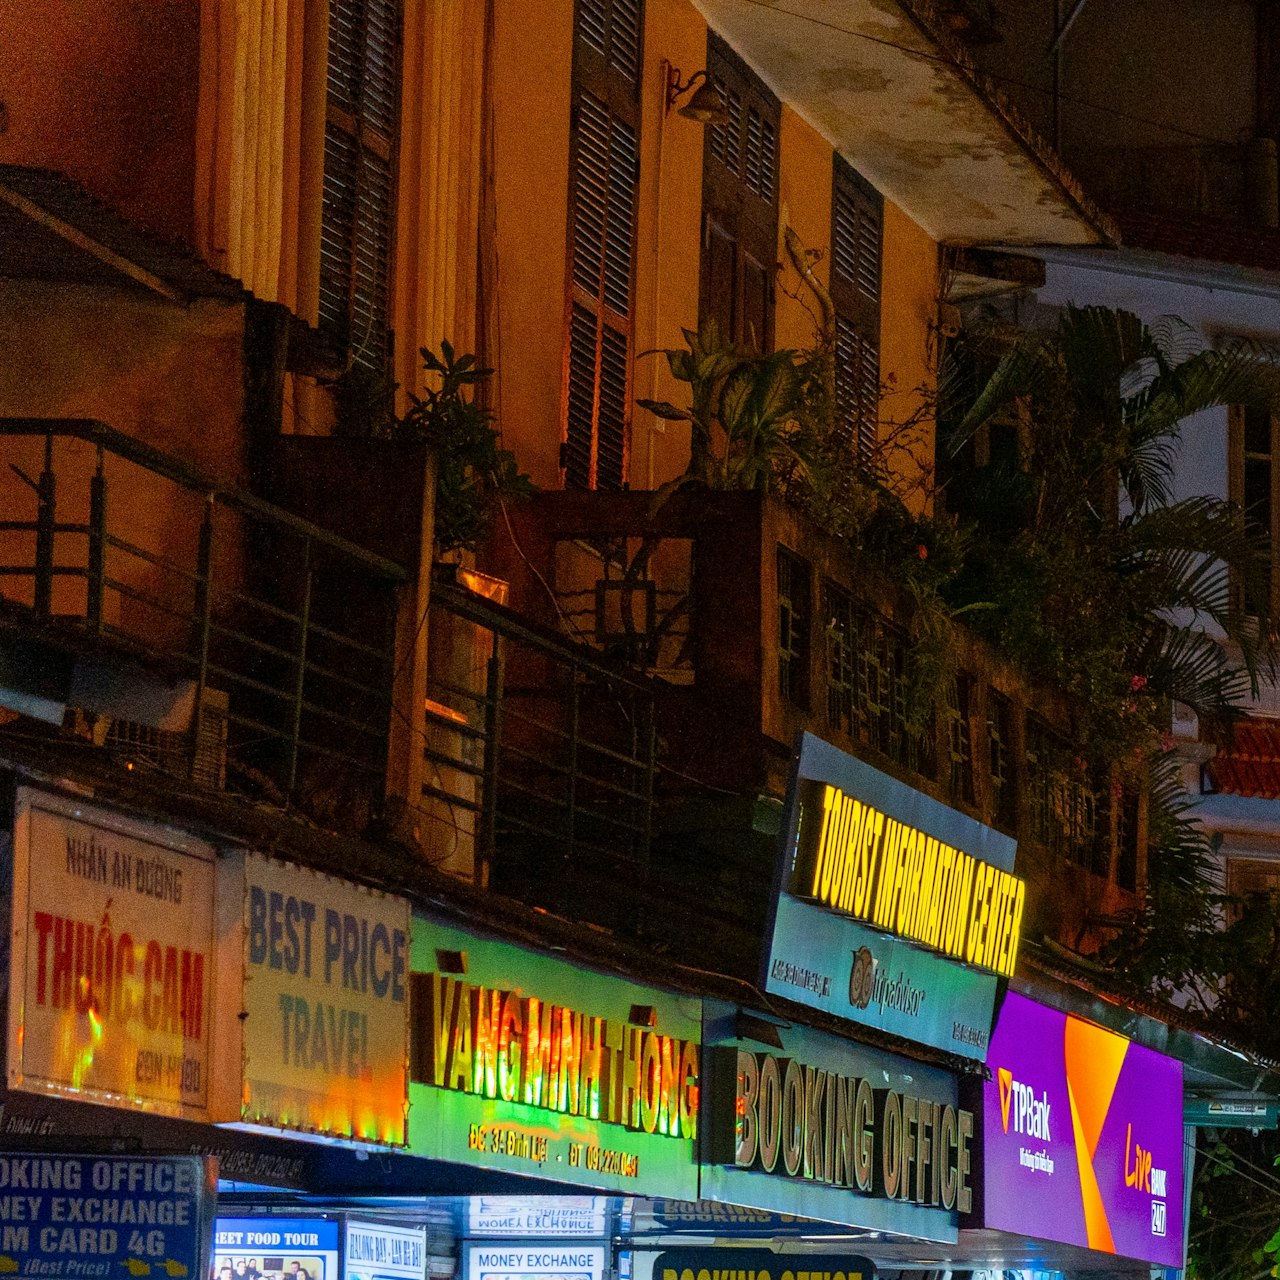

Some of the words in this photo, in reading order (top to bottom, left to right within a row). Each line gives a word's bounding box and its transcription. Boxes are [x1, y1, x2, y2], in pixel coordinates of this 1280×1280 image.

[812, 784, 884, 919] TOURIST
[873, 816, 976, 957] INFORMATION
[966, 860, 1026, 977] CENTER
[249, 885, 316, 979] BEST
[324, 905, 407, 1002] PRICE
[872, 968, 926, 1016] tripadvisor
[280, 994, 369, 1079] TRAVEL
[1012, 1080, 1051, 1141] TPBank
[736, 1049, 874, 1193] BOOKING
[882, 1087, 974, 1214] OFFICE
[92, 1161, 192, 1193] OFFICE
[1124, 1122, 1152, 1193] Live
[1151, 1167, 1167, 1198] BANK
[50, 1199, 190, 1226] EXCHANGE
[41, 1229, 118, 1254] CARD
[128, 1230, 165, 1255] 4G
[246, 1232, 280, 1245] FOOD
[284, 1233, 319, 1246] TOUR
[350, 1234, 374, 1259] HALONG
[375, 1237, 387, 1263] BAY
[24, 1259, 61, 1276] (Best
[65, 1260, 111, 1277] Price)
[478, 1254, 523, 1267] MONEY
[526, 1254, 594, 1267] EXCHANGE
